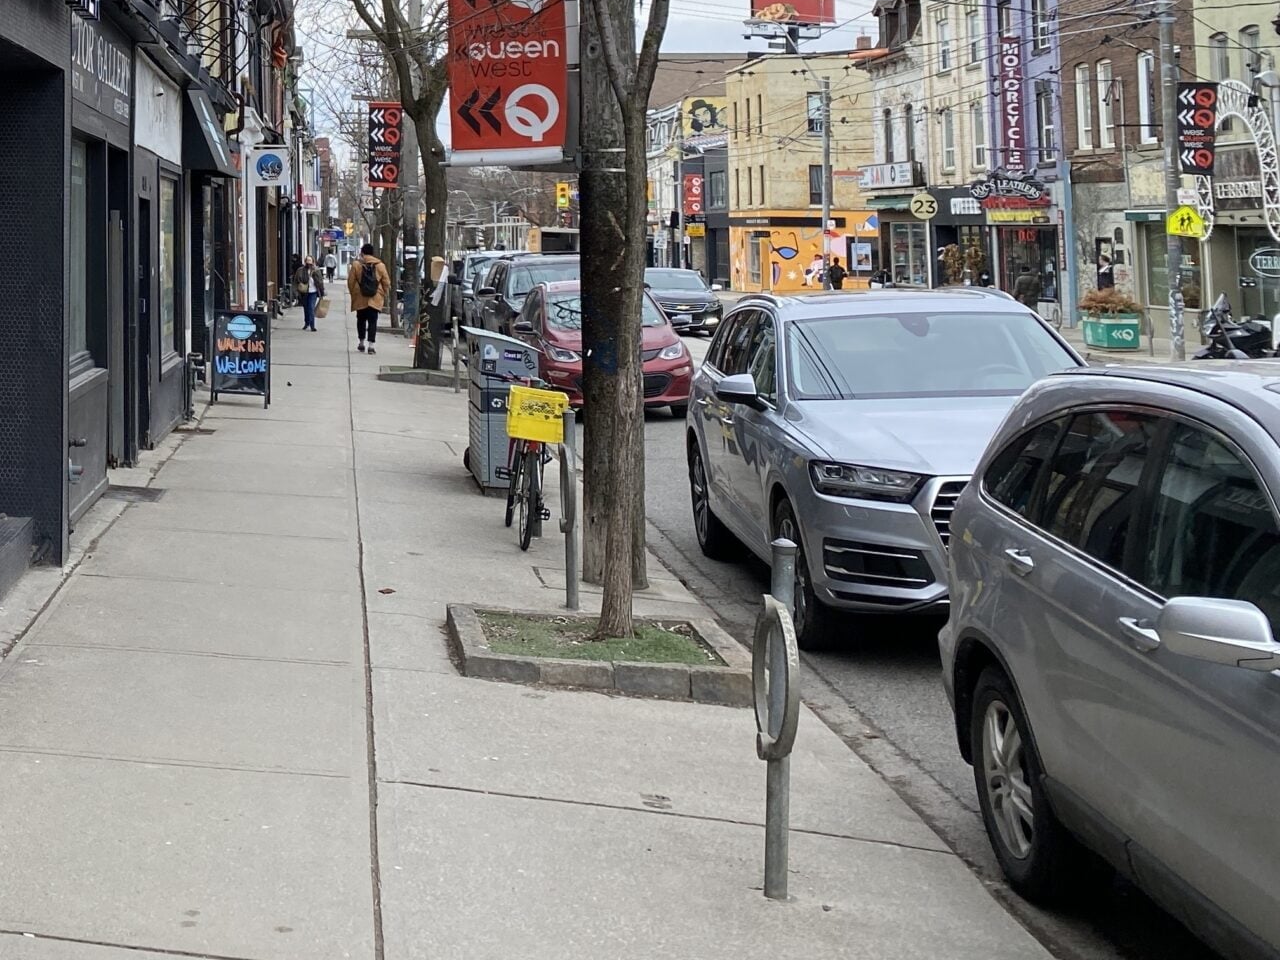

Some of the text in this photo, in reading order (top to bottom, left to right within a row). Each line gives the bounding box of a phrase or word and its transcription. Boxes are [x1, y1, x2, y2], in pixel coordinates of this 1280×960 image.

[98, 36, 130, 97] GALLERY
[471, 60, 532, 78] west
[505, 84, 560, 142] Q
[1002, 43, 1021, 164] MOTORCYCLE
[970, 178, 1041, 198] DOC'S LEATHERS
[913, 200, 936, 214] 23
[217, 337, 265, 353] WALK INS
